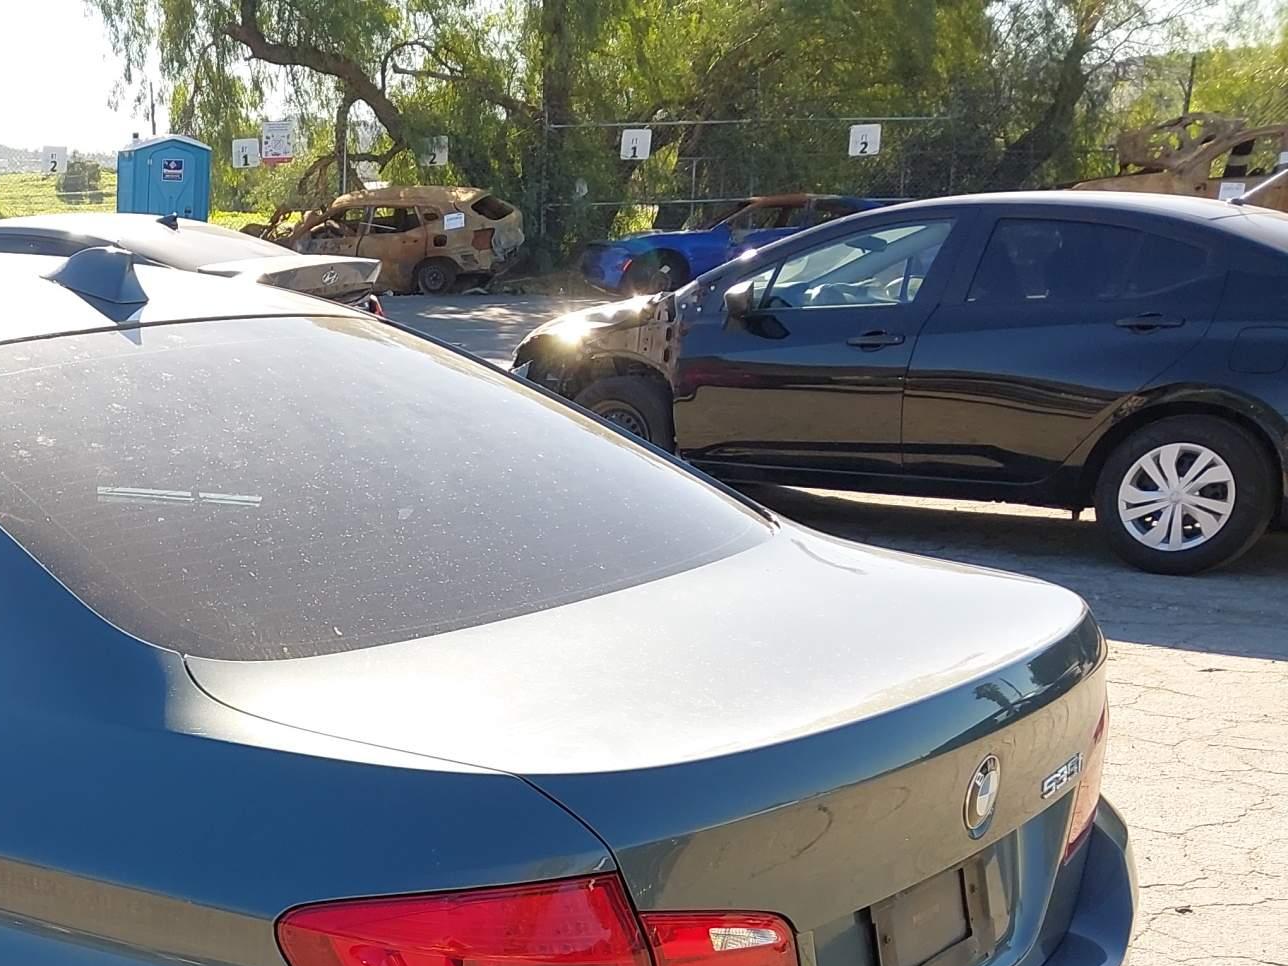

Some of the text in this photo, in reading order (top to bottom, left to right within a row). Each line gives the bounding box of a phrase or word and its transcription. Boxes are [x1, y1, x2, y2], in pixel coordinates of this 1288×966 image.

[631, 146, 638, 158] 1
[859, 141, 869, 154] 2
[242, 154, 250, 166] 1
[428, 152, 437, 165] 2
[50, 160, 58, 172] 2
